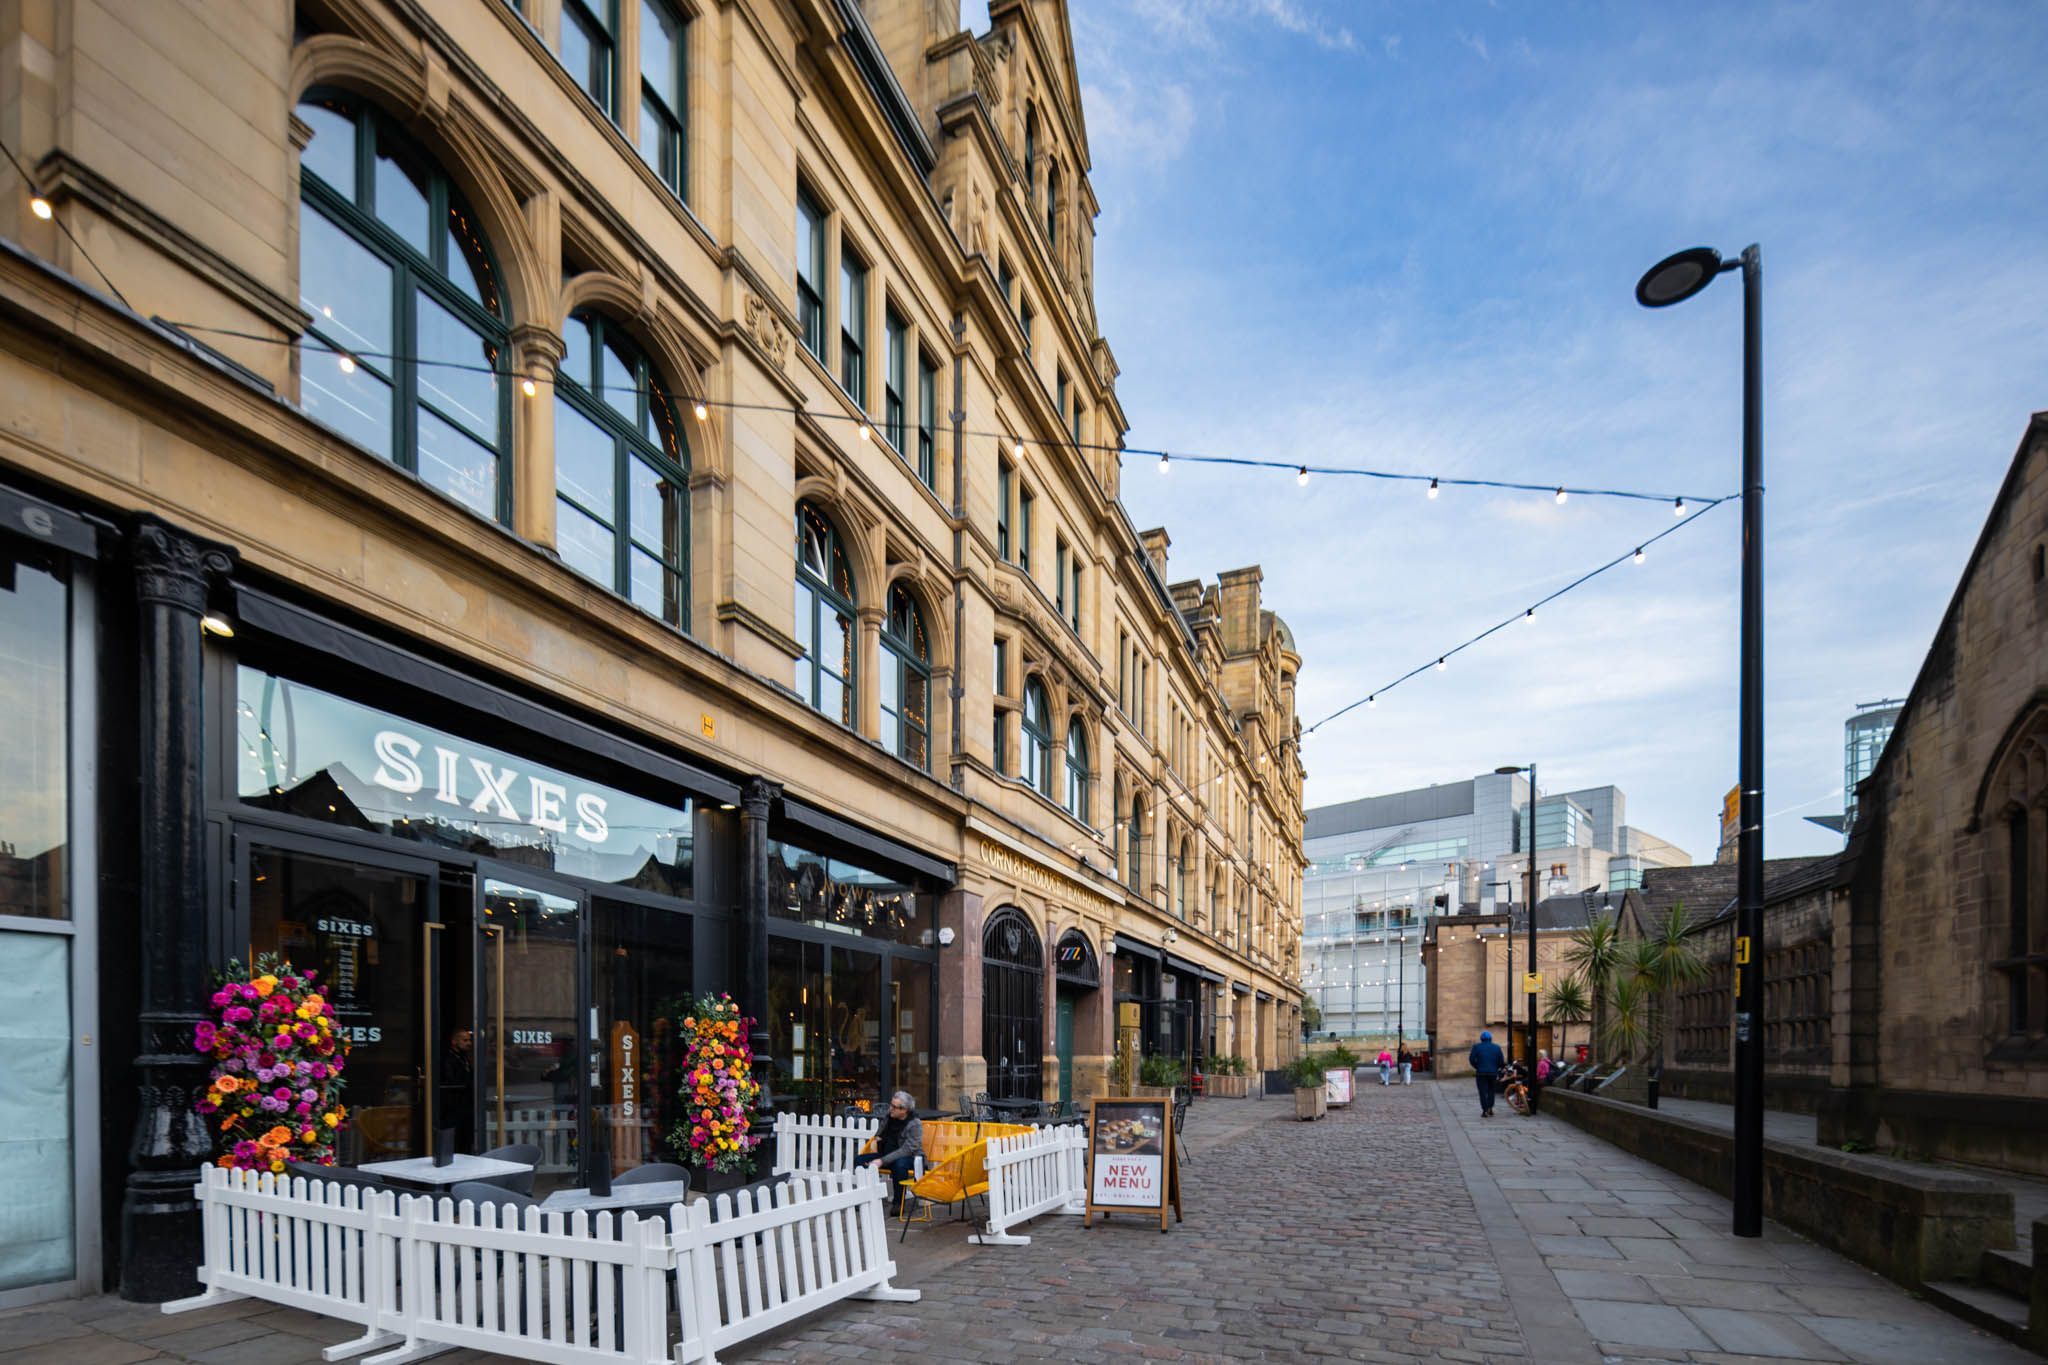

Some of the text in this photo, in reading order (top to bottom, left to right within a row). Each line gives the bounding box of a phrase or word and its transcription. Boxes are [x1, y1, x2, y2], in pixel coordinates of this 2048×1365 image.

[374, 731, 609, 843] SIXES
[981, 840, 1012, 874] CORN
[1013, 856, 1022, 877] &
[1022, 860, 1062, 897] PRODUCE
[318, 919, 373, 936] SIXES
[513, 1030, 552, 1044] SIXES
[622, 1035, 634, 1116] SIXES
[1109, 1164, 1147, 1177] NEW
[1103, 1177, 1151, 1189] MENU
